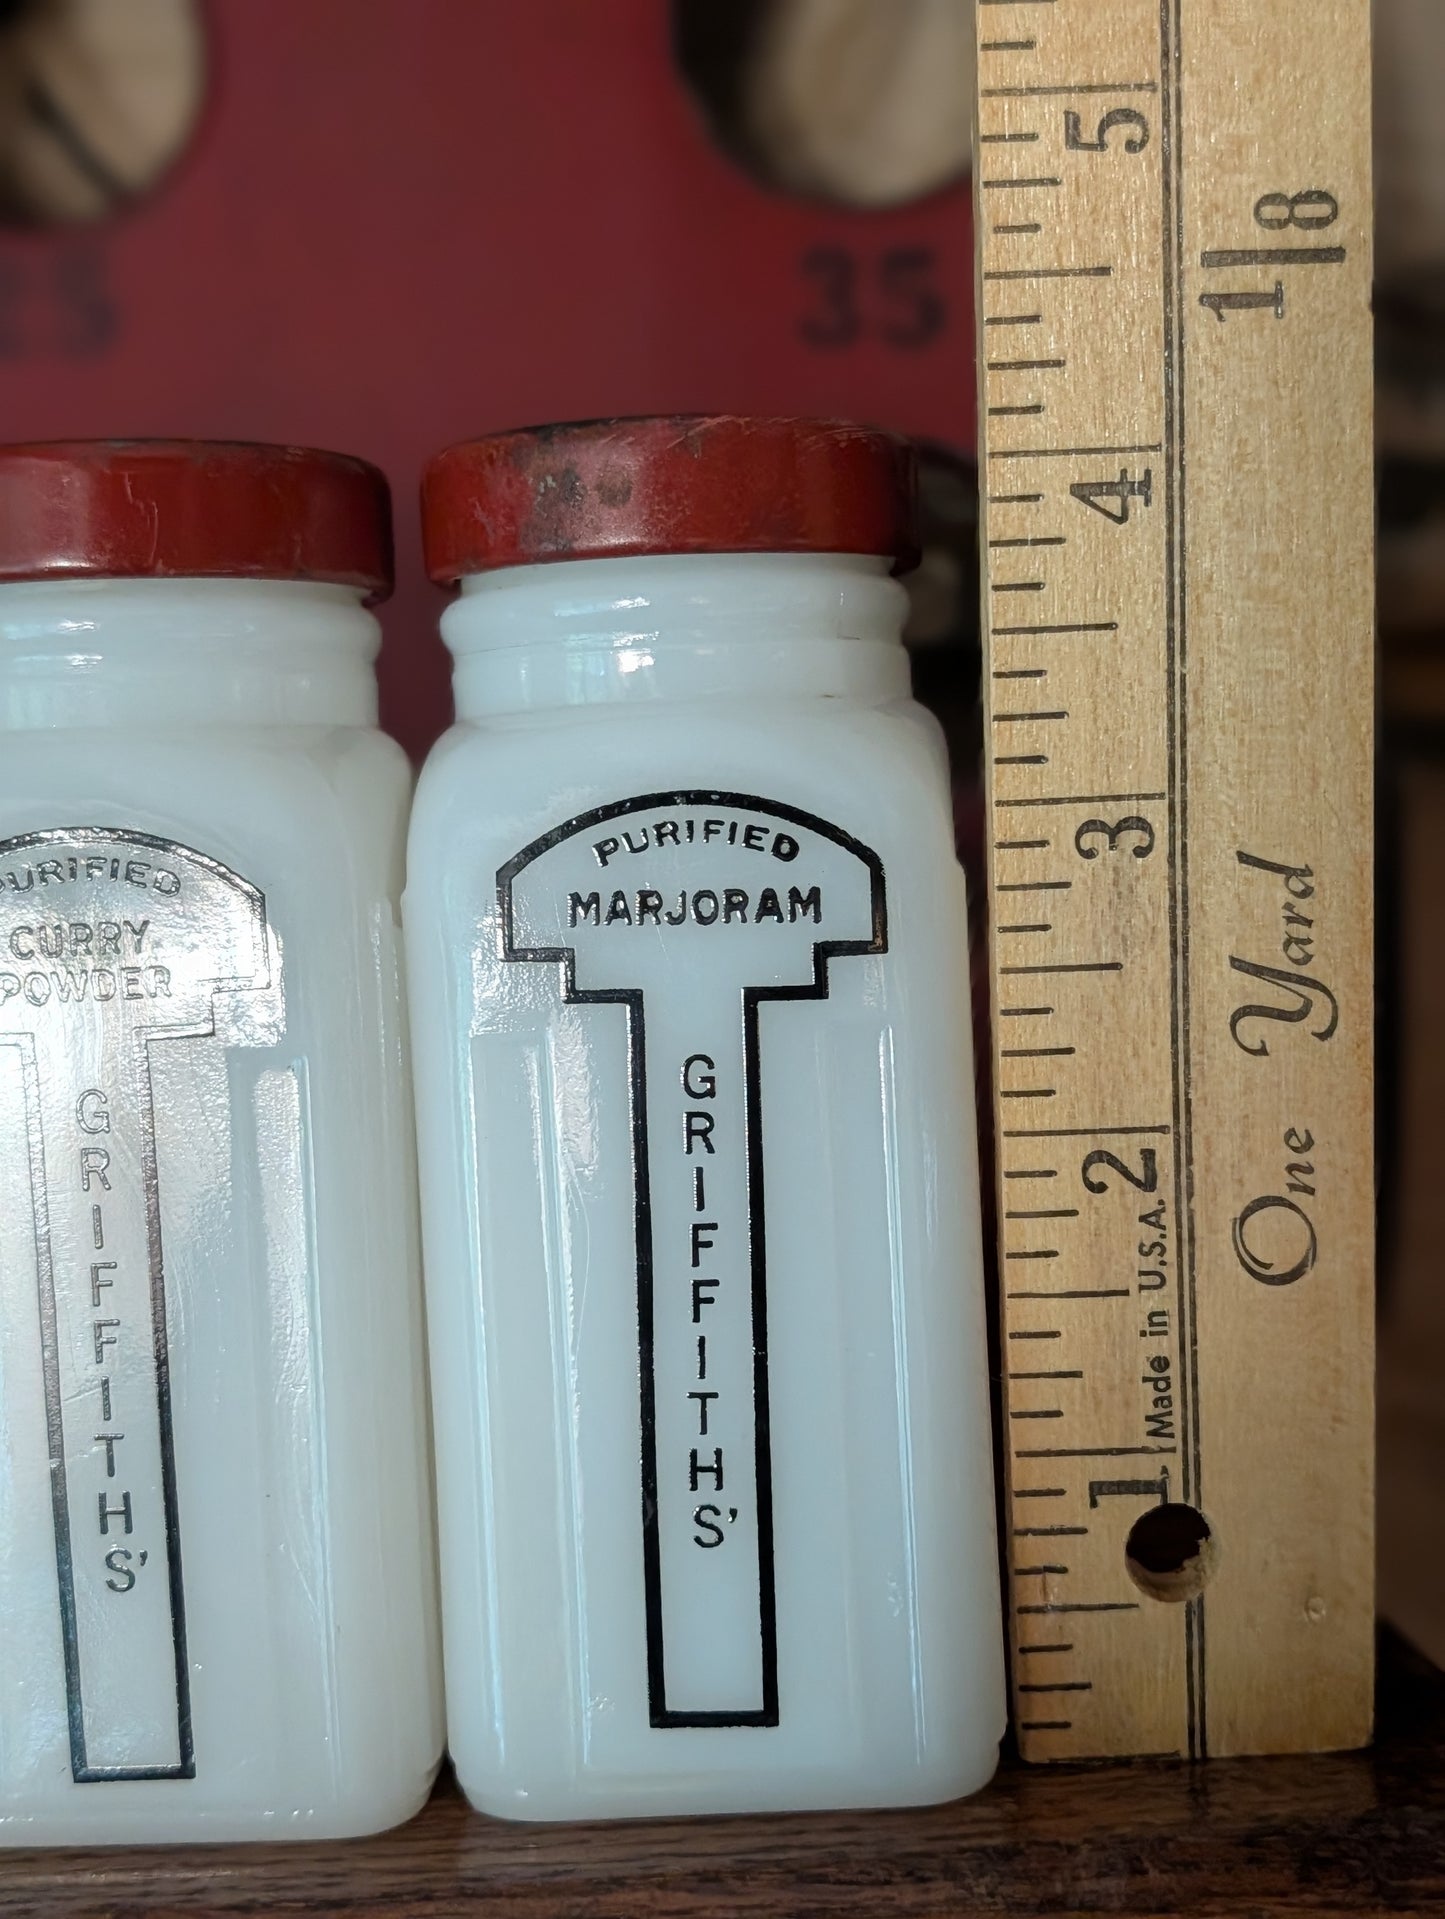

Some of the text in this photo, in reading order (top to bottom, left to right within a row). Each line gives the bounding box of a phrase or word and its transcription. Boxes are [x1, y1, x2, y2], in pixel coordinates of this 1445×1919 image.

[1064, 107, 1151, 155] 5
[797, 244, 945, 352] 35
[1069, 467, 1153, 526] 4
[591, 818, 801, 868] PURIFIED
[1074, 815, 1156, 860] 3
[0, 856, 182, 897] URIFIED
[566, 885, 824, 928] MARJORAM
[10, 919, 150, 960] CURRY
[0, 964, 172, 1007] POWDER
[1227, 849, 1339, 1286] One Yard
[1081, 1148, 1157, 1194] 2
[679, 1053, 738, 1549] GRIFFITHS'
[1137, 1198, 1176, 1440] Made in U.S.A.
[75, 1088, 149, 1593] GRIFFITHS'
[1088, 1464, 1170, 1510] 1
